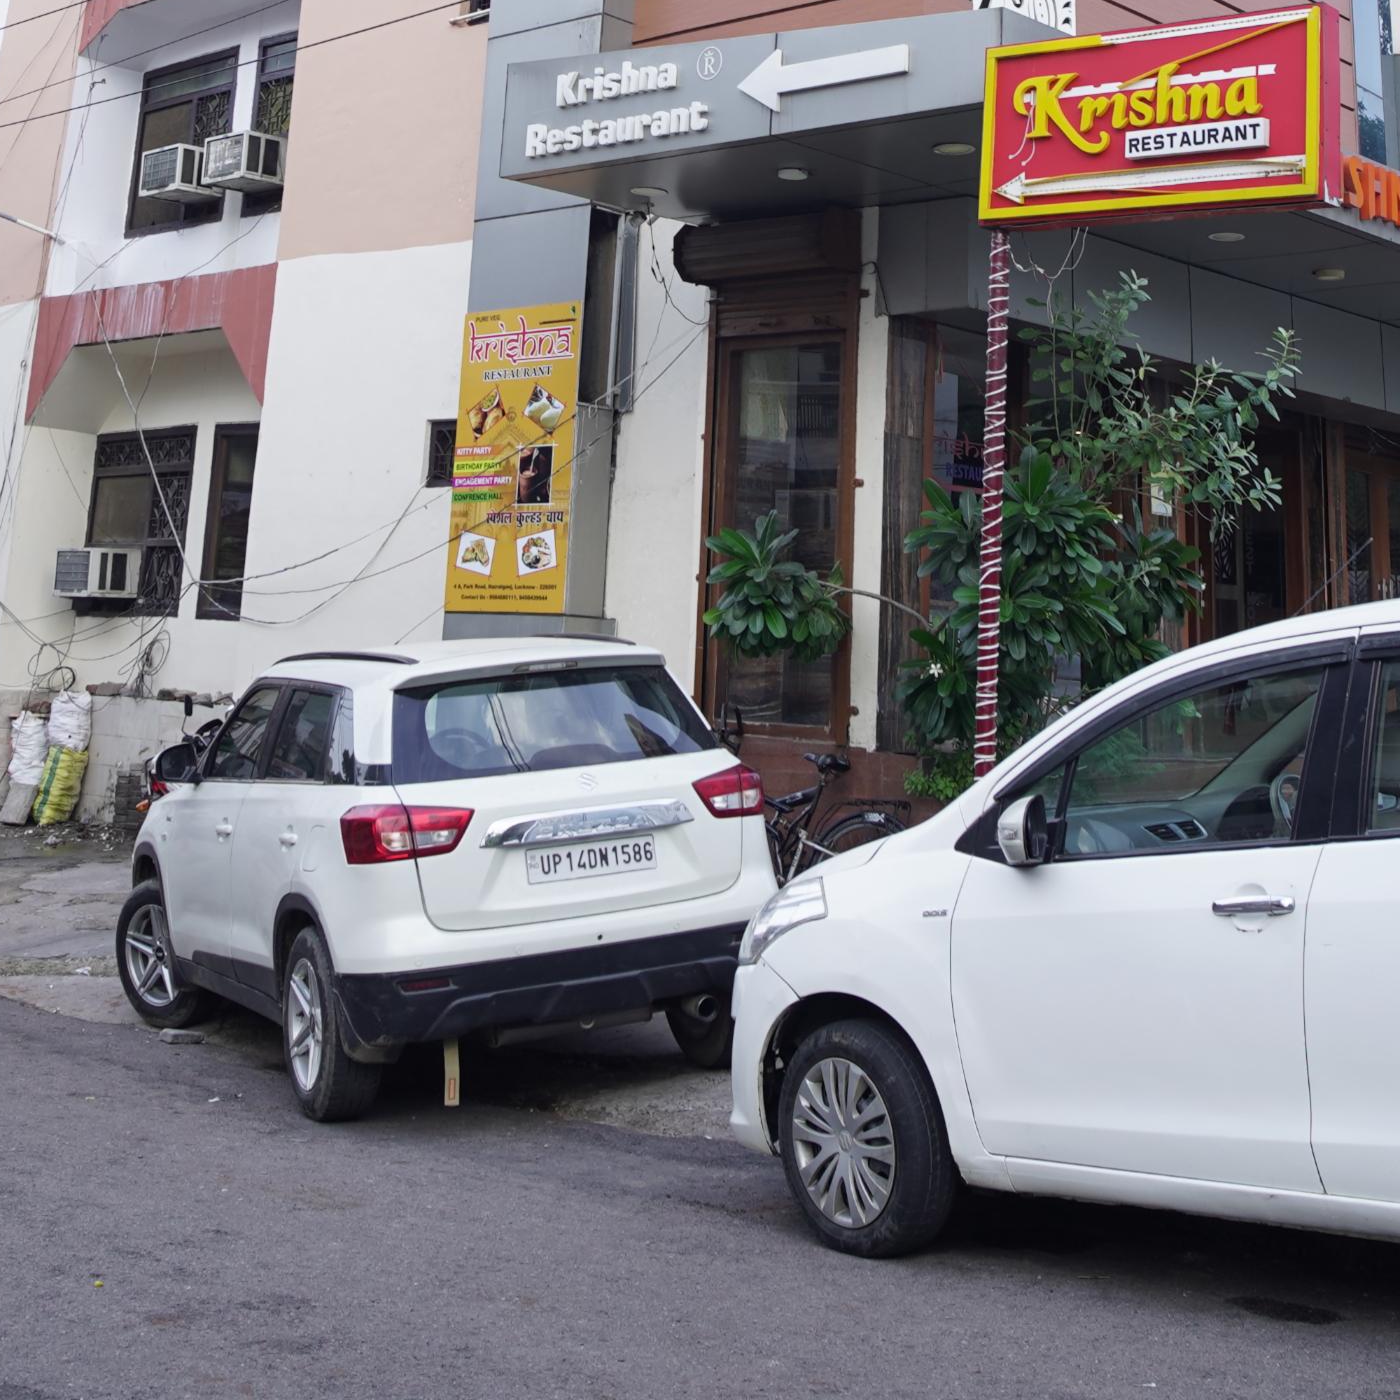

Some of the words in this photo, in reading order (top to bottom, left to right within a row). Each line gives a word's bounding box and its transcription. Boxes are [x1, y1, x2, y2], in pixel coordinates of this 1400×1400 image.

[556, 60, 678, 107] Krishna
[1013, 62, 1263, 154] Krishna
[525, 101, 709, 158] Restaurant
[1128, 123, 1261, 153] RESTAURANT
[469, 315, 574, 365] krishna
[484, 365, 553, 381] RESTAURANT
[473, 446, 492, 454] PARTY
[456, 462, 482, 470] BIRTHDAY
[483, 461, 501, 469] PARTY
[454, 477, 493, 486] ENGAGEMENT
[493, 476, 512, 484] PARTY
[454, 493, 489, 501] CONFRENCE
[490, 492, 503, 500] HALL
[546, 511, 564, 523] चाय
[540, 842, 654, 875] UP14DN1586
